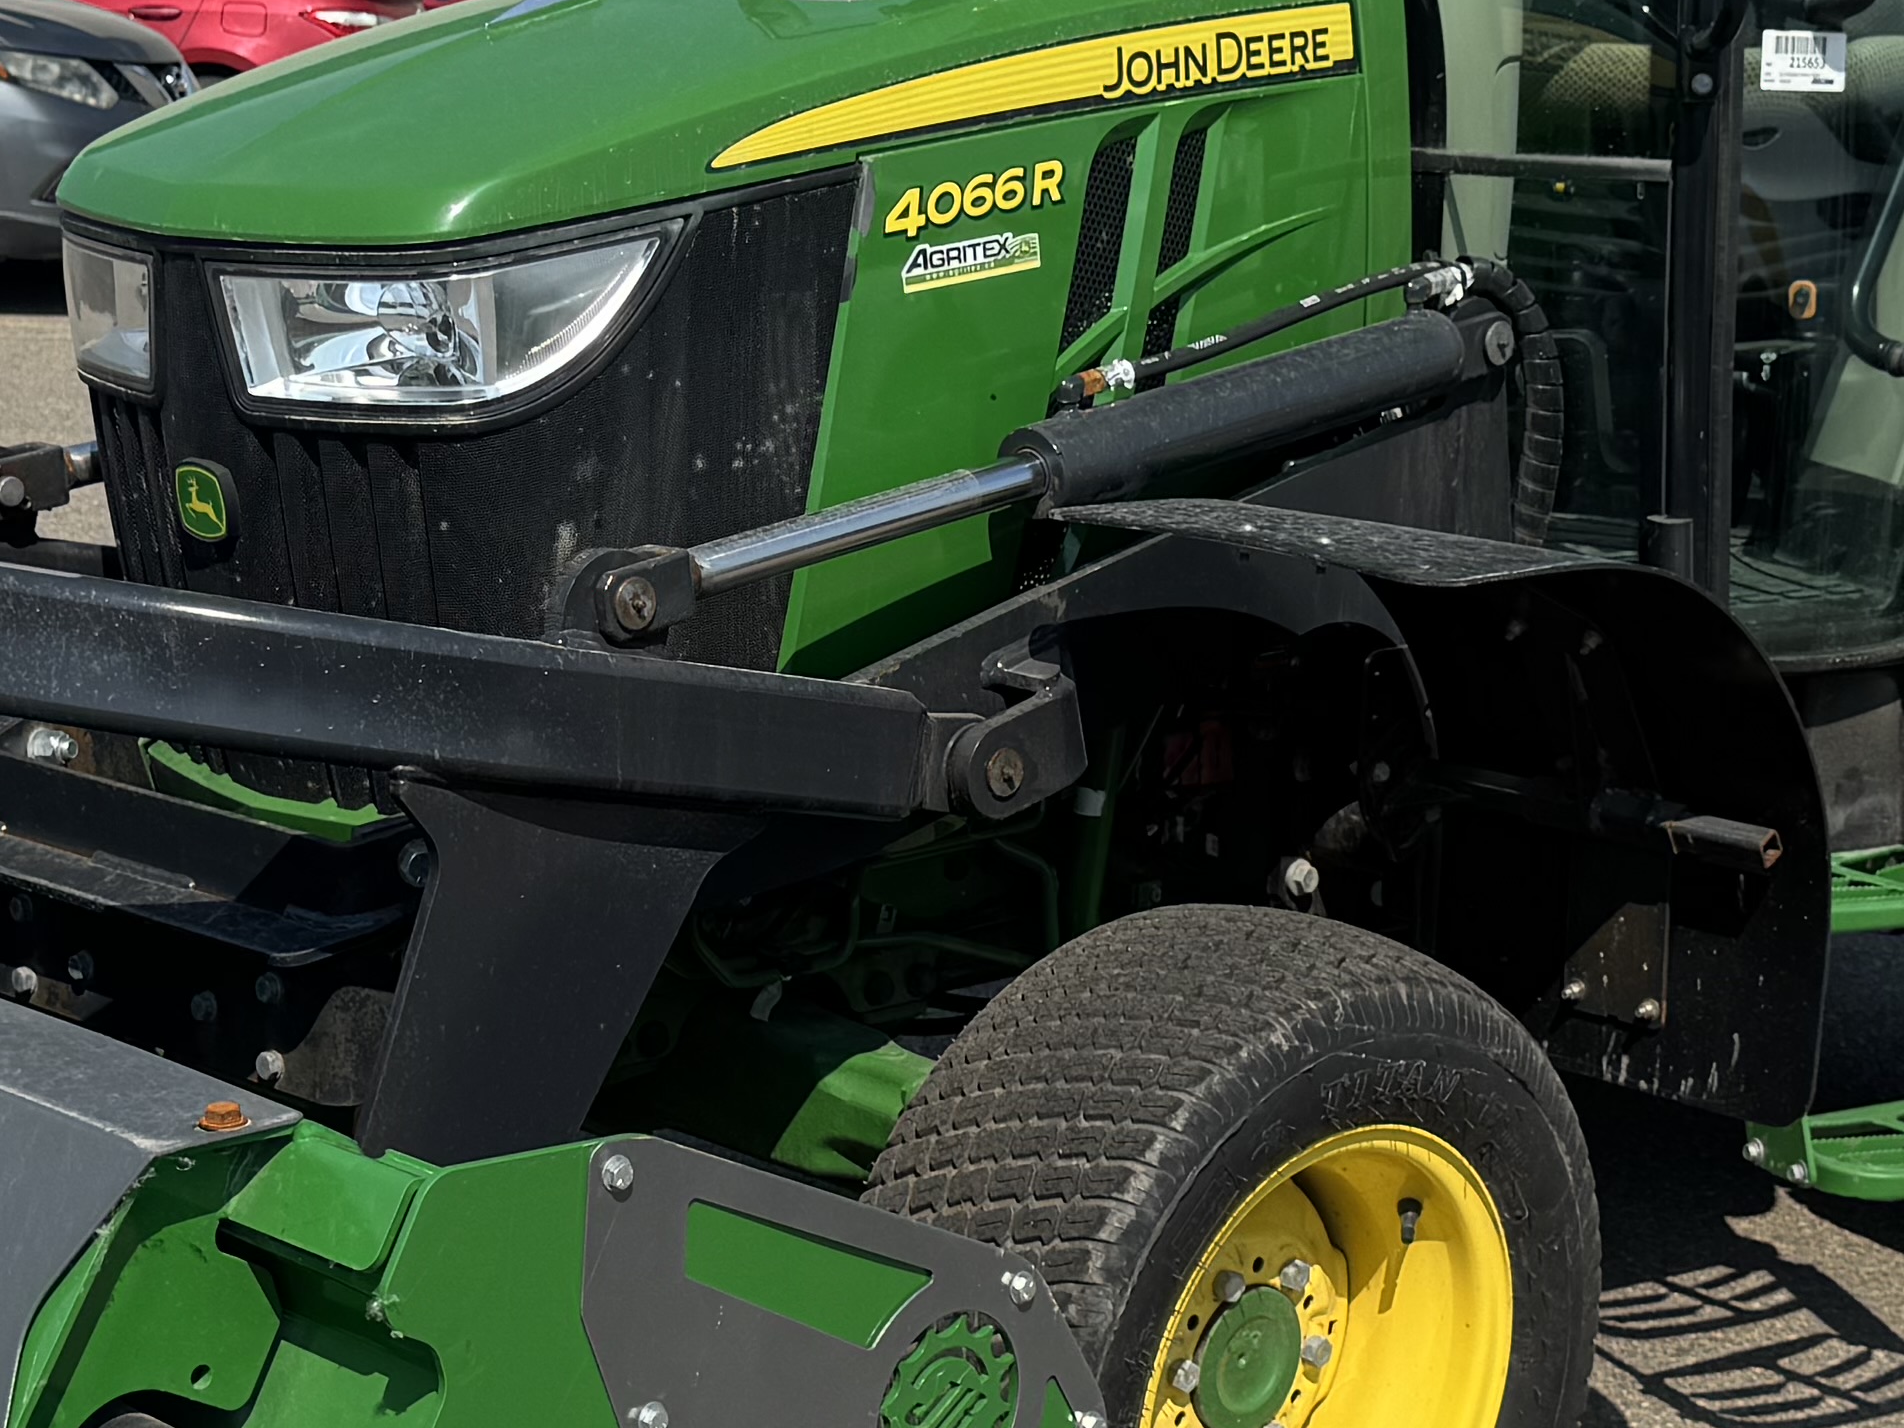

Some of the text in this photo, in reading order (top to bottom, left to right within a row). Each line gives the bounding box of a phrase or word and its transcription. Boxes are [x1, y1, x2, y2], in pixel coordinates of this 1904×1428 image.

[1103, 27, 1331, 93] JOHN DEERE
[905, 236, 1011, 274] AGRITEX
